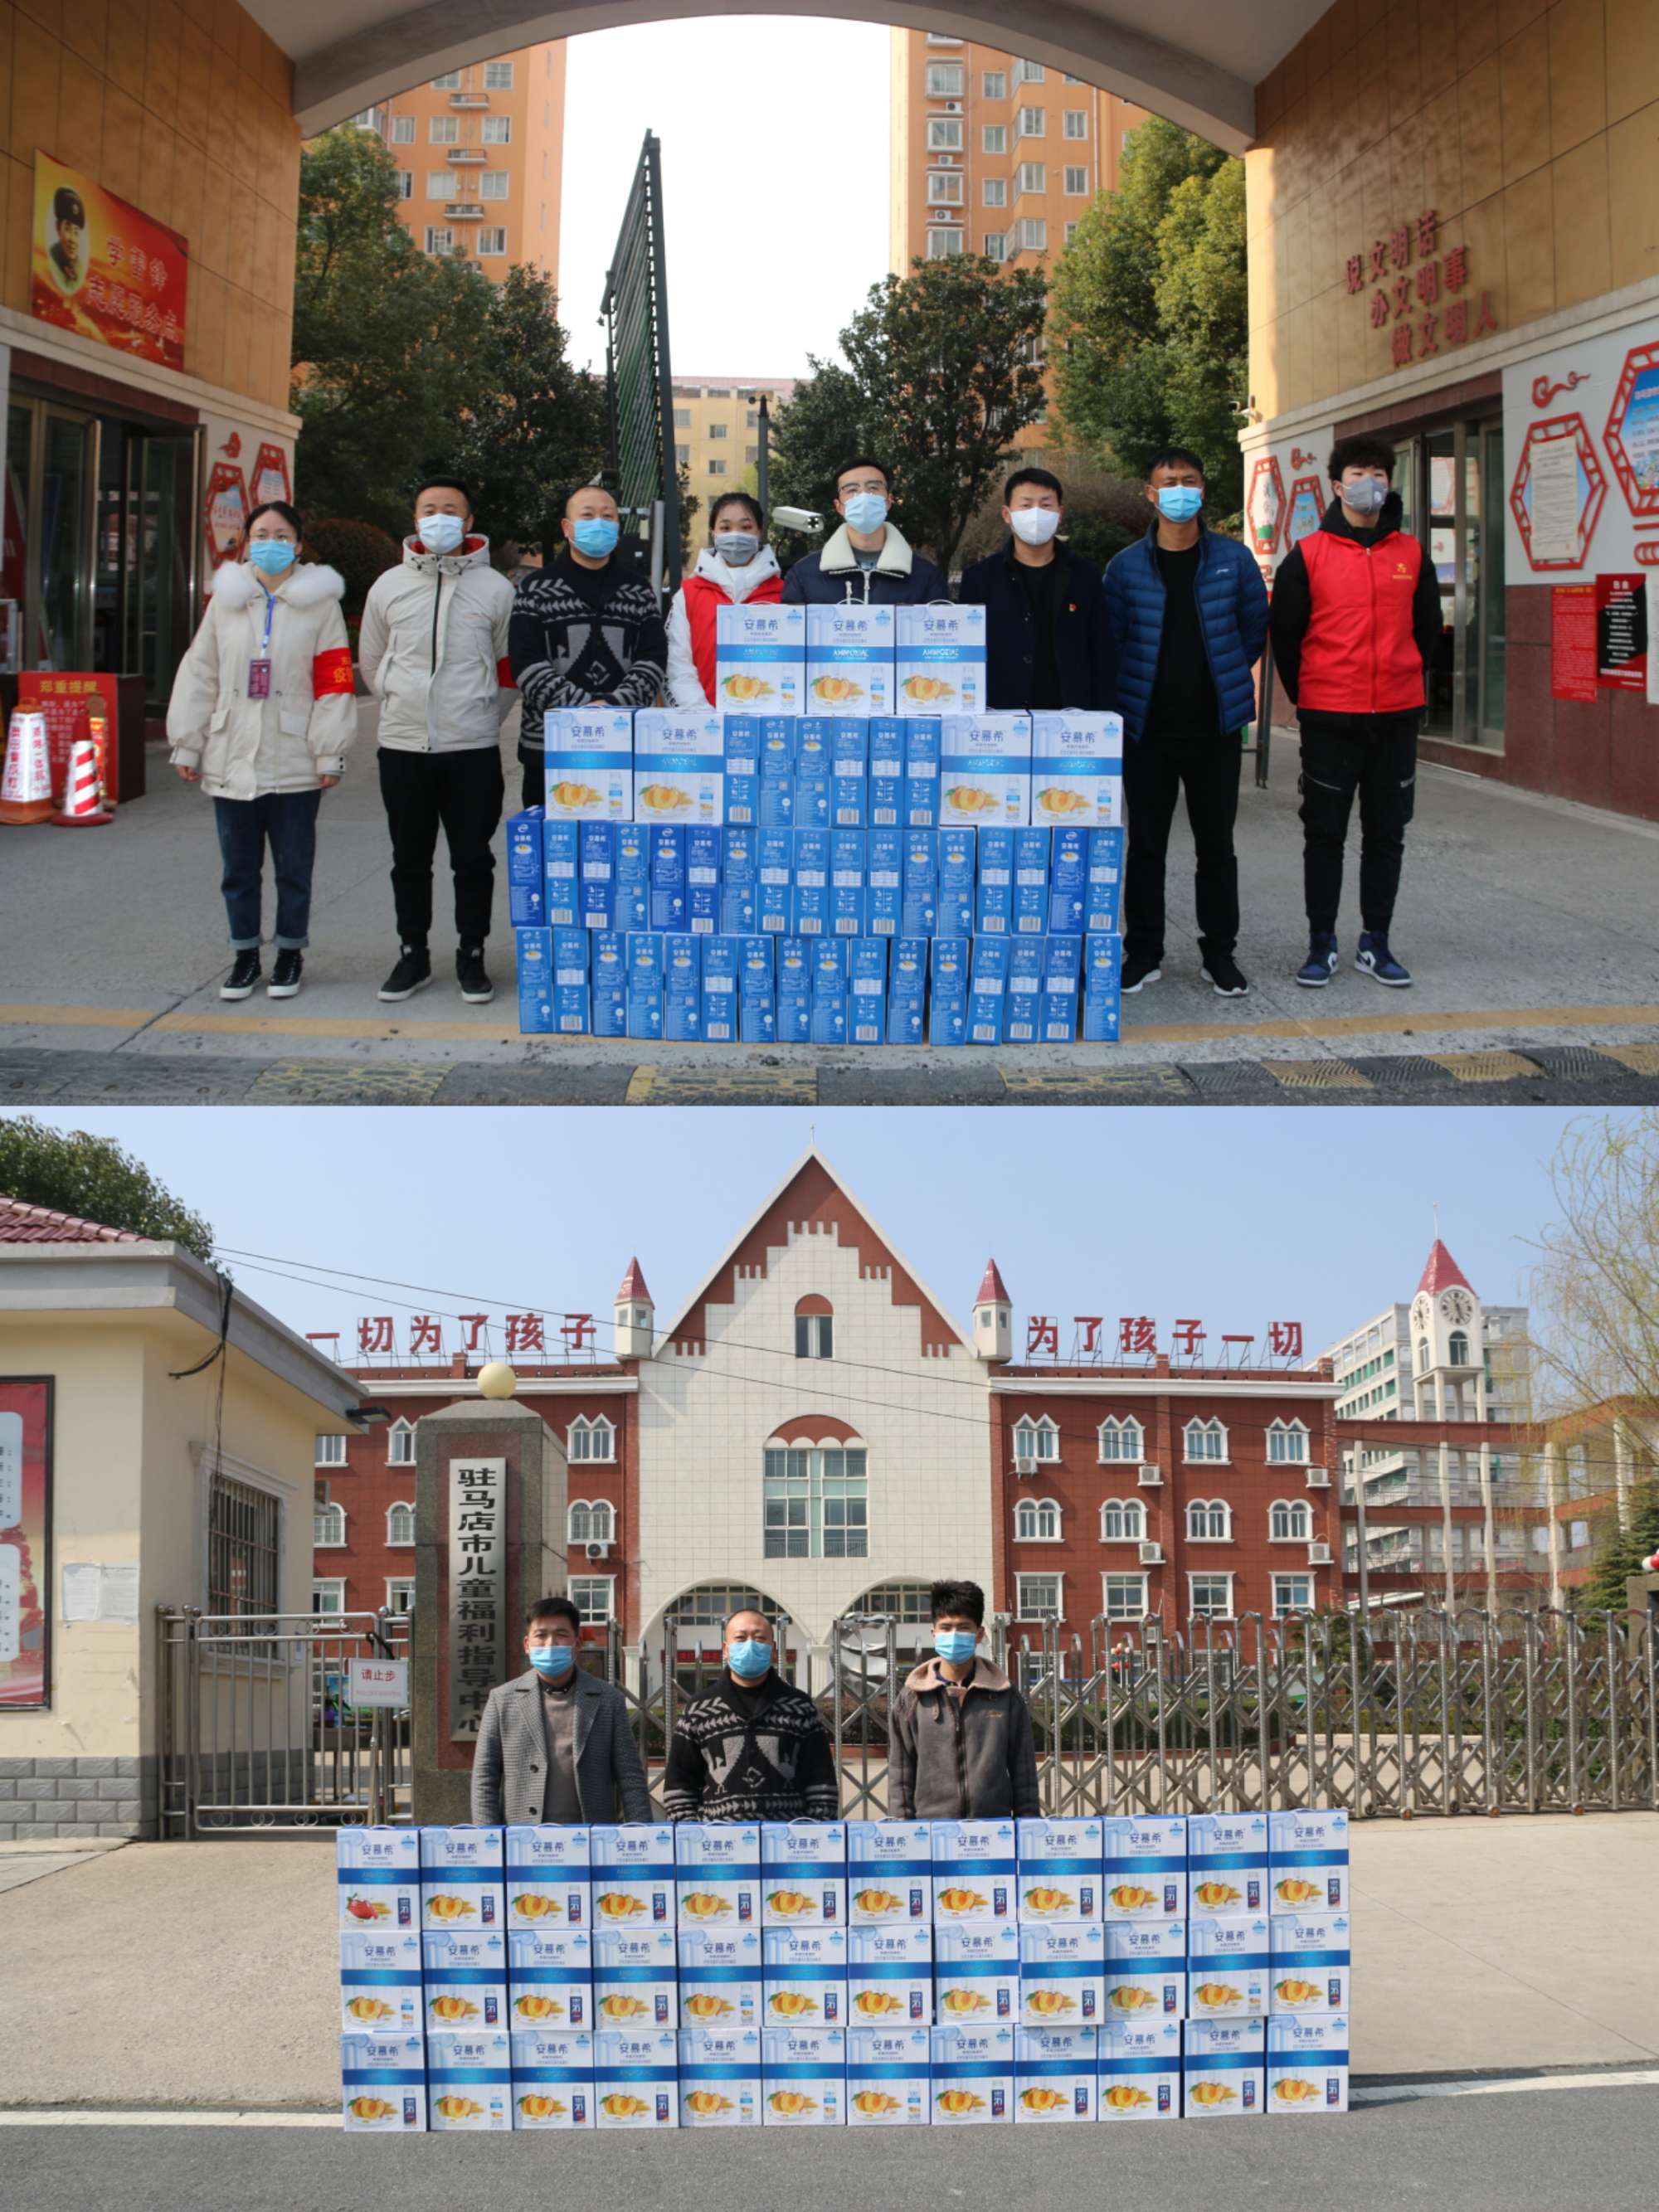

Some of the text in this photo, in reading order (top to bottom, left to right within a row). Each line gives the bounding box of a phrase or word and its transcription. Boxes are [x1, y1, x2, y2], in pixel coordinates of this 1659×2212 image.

[1347, 210, 1437, 294] 说文明话
[1371, 246, 1467, 328] 办文明事
[1391, 291, 1498, 368] 做文明人
[744, 619, 779, 630] 安慕希
[834, 620, 868, 631] 安慕希
[924, 619, 958, 630] 安慕希
[571, 726, 605, 737] 安慕希
[663, 728, 697, 741] 安慕希
[970, 730, 1004, 742] 安慕希
[1060, 732, 1095, 743] 安慕希
[305, 1313, 596, 1353] 一切为了孩子
[1028, 1315, 1302, 1355] 为了孩子一切
[1130, 1832, 1161, 1844] 安慕希
[1214, 1829, 1243, 1840] 安慕希
[1294, 1826, 1325, 1838] 安慕希
[702, 1840, 733, 1851] 安慕希
[787, 1839, 819, 1850] 安慕希
[874, 1836, 906, 1848] 安慕希
[957, 1835, 989, 1847] 安慕希
[1045, 1834, 1077, 1846] 安慕希
[362, 1844, 393, 1855] 安慕希
[445, 1843, 477, 1855] 安慕希
[533, 1842, 564, 1853] 安慕希
[616, 1841, 648, 1852] 安慕希
[1214, 1931, 1244, 1942] 安慕希
[1295, 1928, 1325, 1939] 安慕希
[789, 1940, 821, 1952] 安慕希
[874, 1938, 906, 1950] 安慕希
[961, 1937, 993, 1948] 安慕希
[1047, 1937, 1078, 1949] 安慕希
[1129, 1934, 1160, 1946] 安慕希
[365, 1946, 396, 1957] 安慕希
[449, 1945, 479, 1956] 安慕希
[533, 1943, 565, 1955] 安慕希
[619, 1942, 650, 1954] 安慕希
[704, 1942, 736, 1954] 安慕希
[1209, 2030, 1240, 2042] 安慕希
[1293, 2027, 1324, 2038] 安慕希
[704, 2039, 735, 2051] 安慕希
[788, 2039, 819, 2051] 安慕希
[873, 2039, 904, 2050] 安慕希
[956, 2038, 988, 2049] 安慕希
[1041, 2036, 1072, 2048] 安慕希
[1124, 2034, 1155, 2045] 安慕希
[367, 2045, 399, 2056] 安慕希
[453, 2044, 484, 2056] 安慕希
[536, 2044, 567, 2054] 安慕希
[620, 2043, 650, 2054] 安慕希
